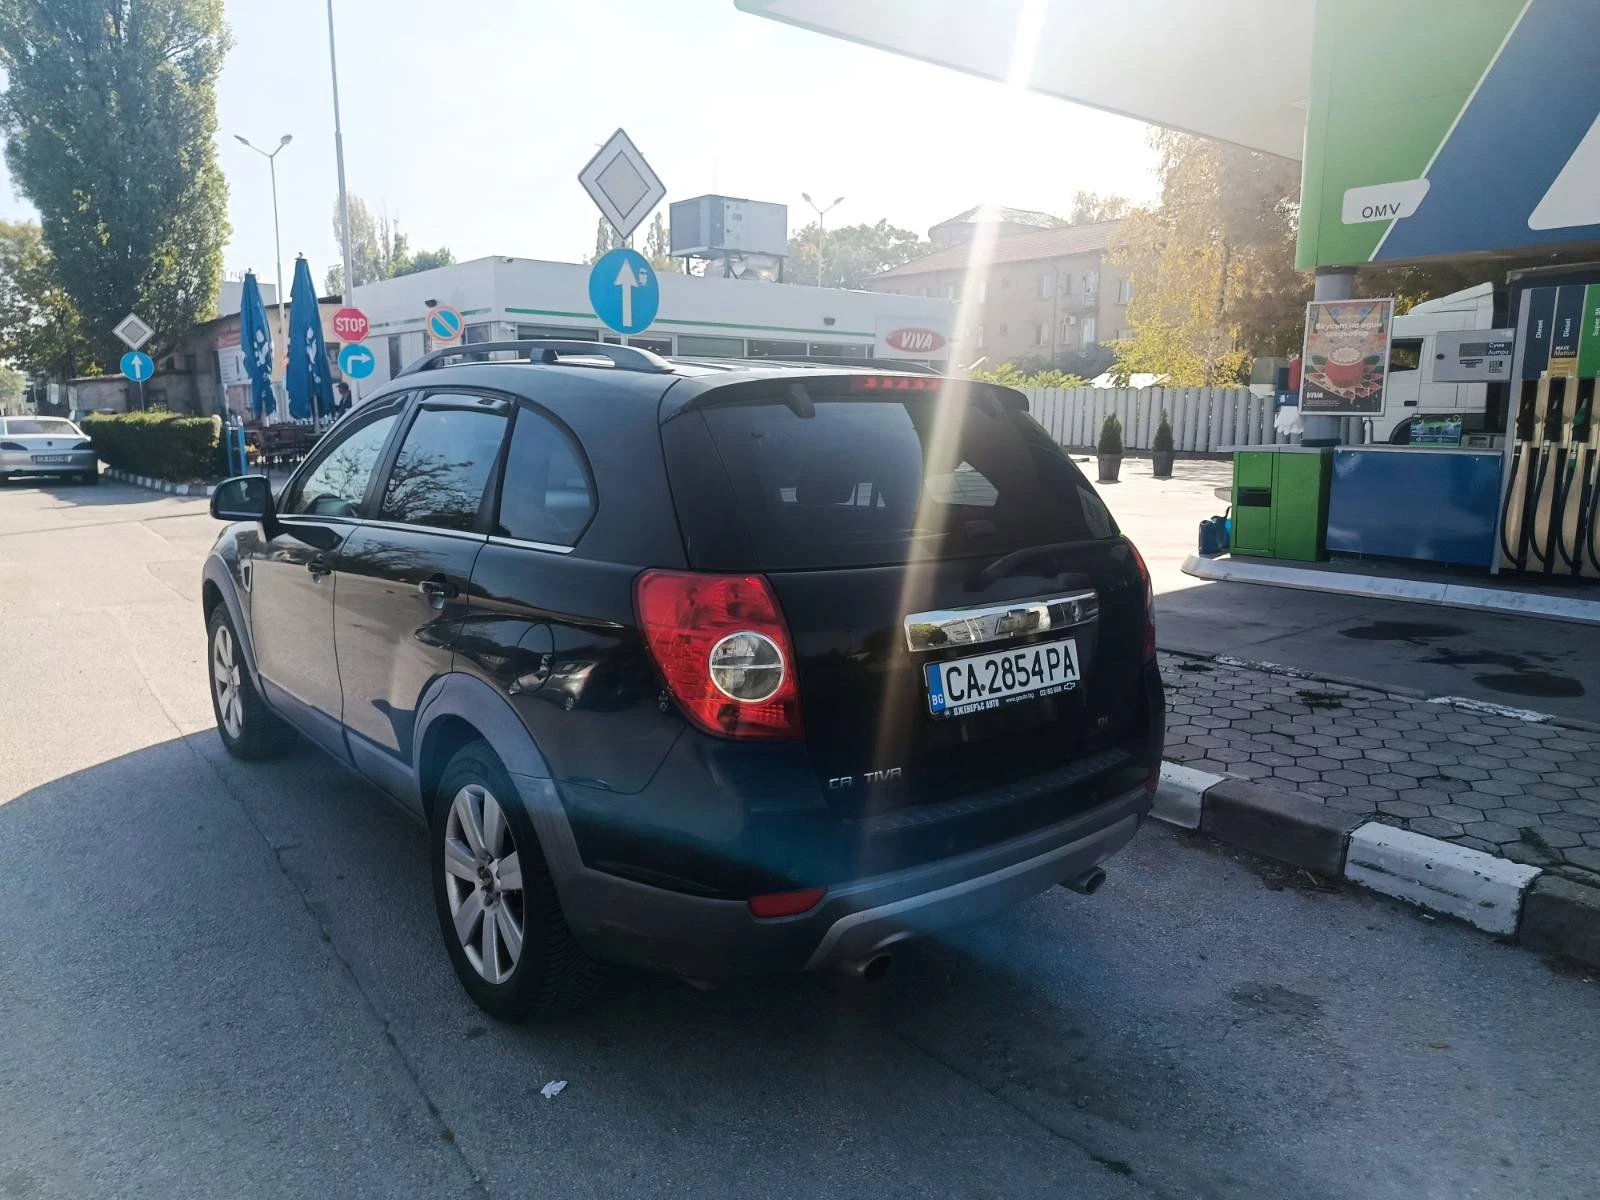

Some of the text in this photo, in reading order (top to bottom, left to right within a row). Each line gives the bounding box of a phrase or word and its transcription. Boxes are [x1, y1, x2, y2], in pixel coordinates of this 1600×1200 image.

[1361, 202, 1401, 219] OMV
[336, 318, 366, 332] STOP
[1536, 320, 1544, 338] Diesel
[1563, 318, 1571, 337] Diesel
[901, 331, 933, 349] VIVA
[931, 693, 944, 706] BG
